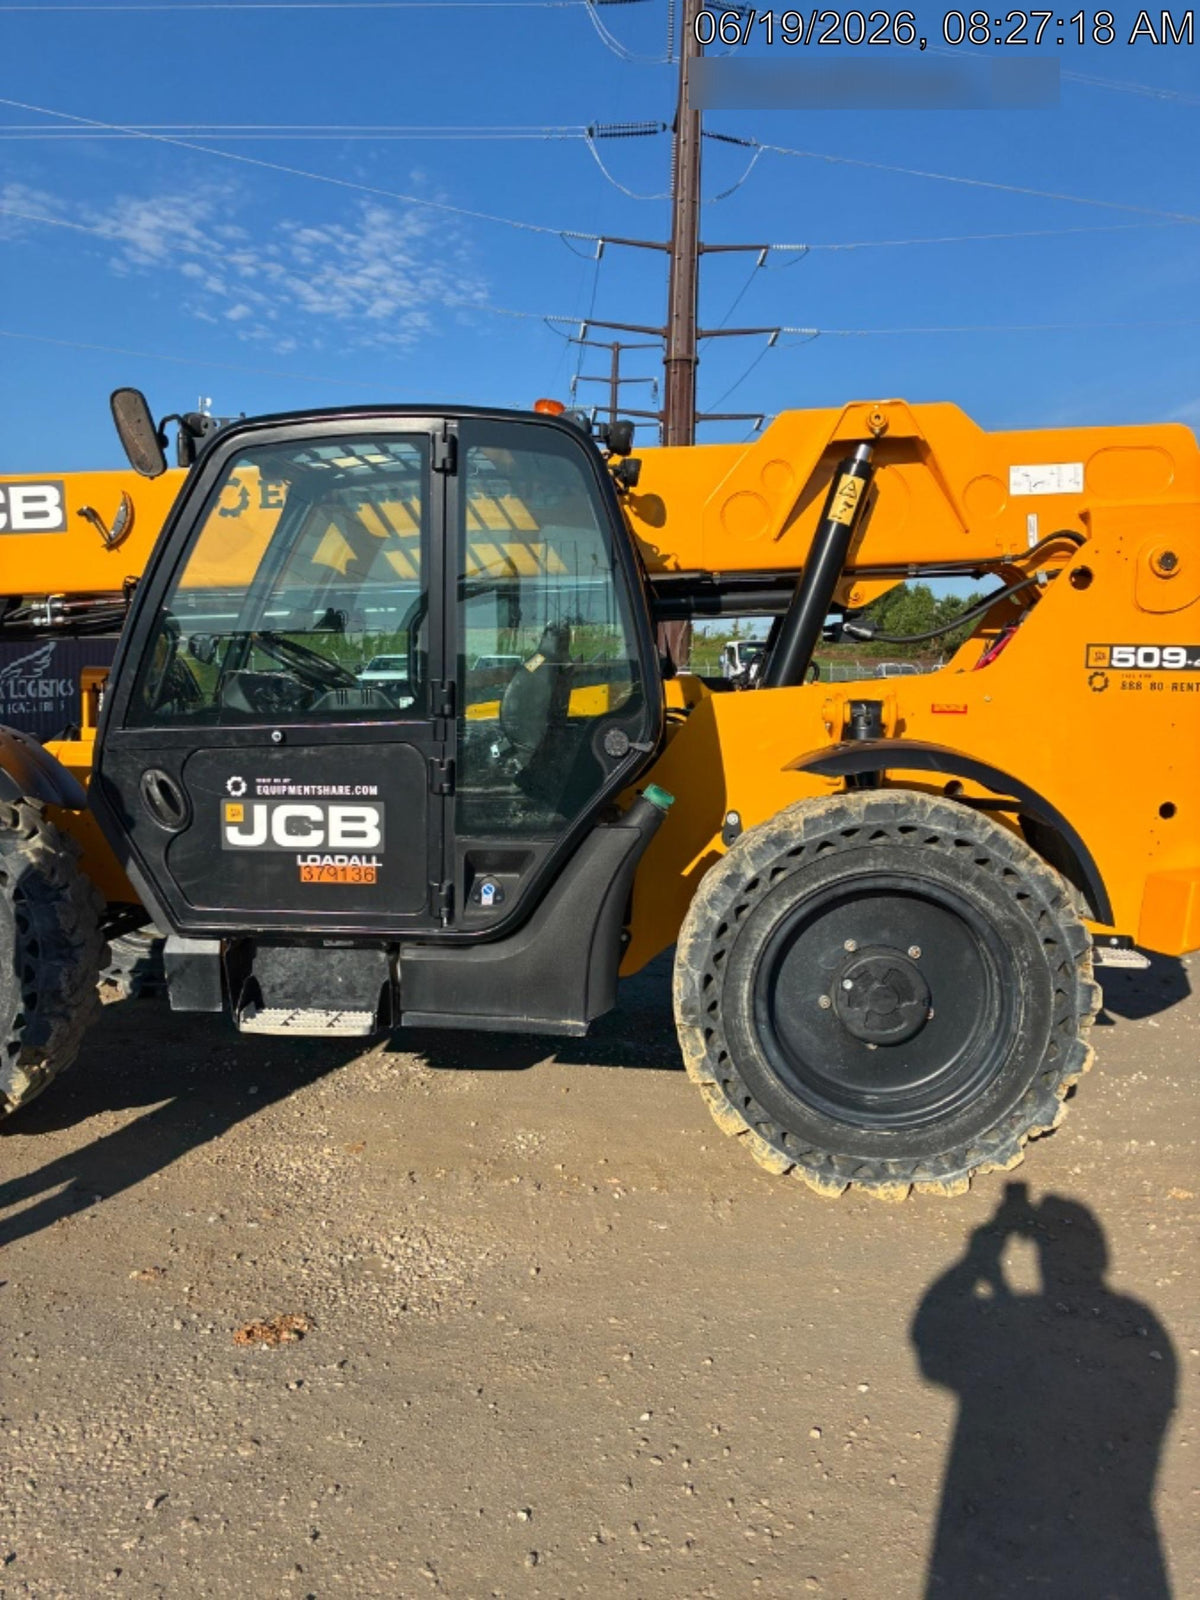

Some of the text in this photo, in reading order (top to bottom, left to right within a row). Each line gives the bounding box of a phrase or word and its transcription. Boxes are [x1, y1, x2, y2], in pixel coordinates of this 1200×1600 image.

[256, 785, 378, 796] EQUIPMENTSHARE.COM
[225, 804, 381, 848] JCB
[296, 855, 383, 867] LOADALL
[302, 865, 374, 882] 379136
